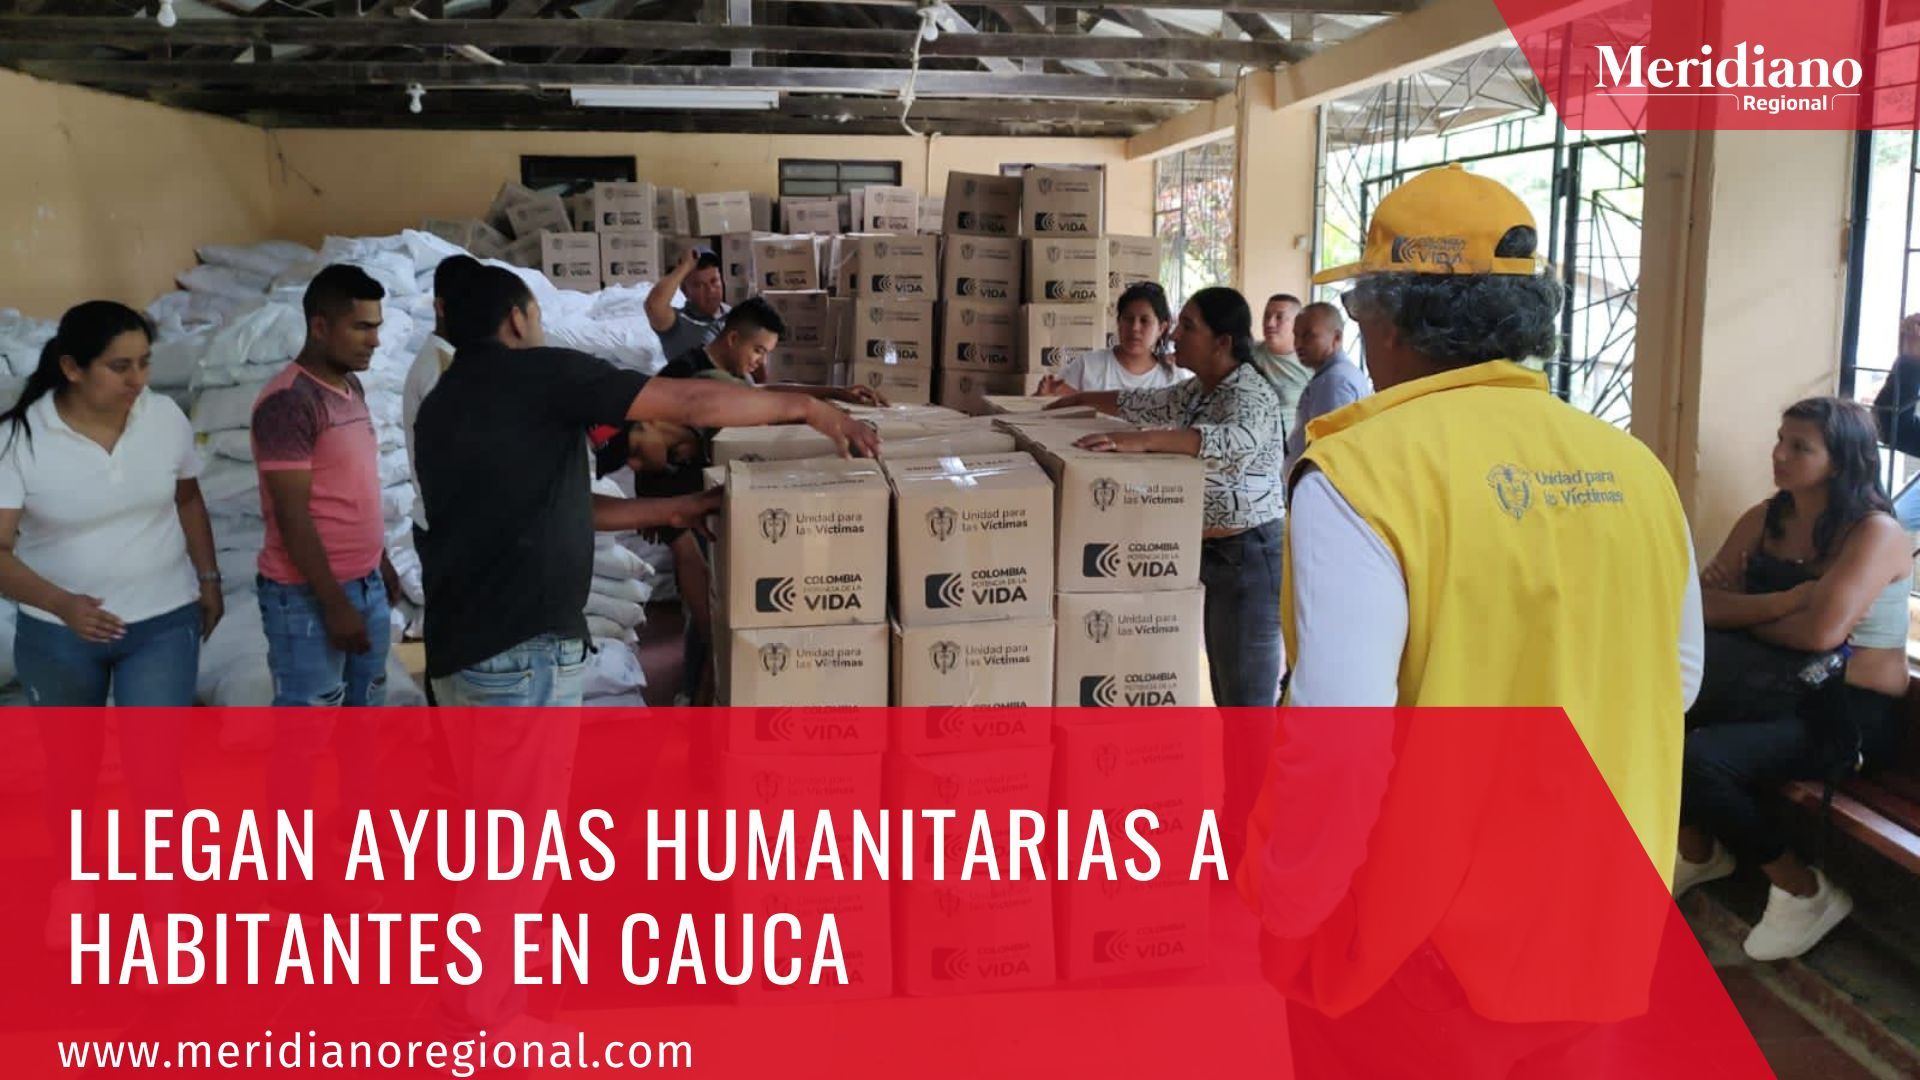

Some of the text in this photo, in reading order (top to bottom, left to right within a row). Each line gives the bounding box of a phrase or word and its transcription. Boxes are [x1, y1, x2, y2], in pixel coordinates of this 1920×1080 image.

[1058, 223, 1087, 232] VIDA
[1069, 290, 1097, 299] VIDA
[1585, 470, 1614, 486] para
[1140, 493, 1185, 505] Víctimas
[796, 512, 863, 526] Unidad para
[962, 508, 1026, 522] Unidad para
[815, 521, 865, 535] Víctimas
[980, 519, 1028, 531] Víctimas
[1128, 542, 1180, 552] COLOMBIA
[971, 566, 1027, 580] COLOMBIA
[1127, 560, 1178, 578] VIDA
[803, 573, 862, 586] COLOMBIA
[804, 592, 863, 612] VIDA
[971, 586, 1028, 605] VIDA
[1118, 613, 1177, 625] Unidad para
[1135, 624, 1180, 636] Víctimas
[796, 647, 862, 660] Unidad para
[966, 643, 1028, 656] Unidad para
[982, 654, 1031, 666] Víctimas
[1124, 671, 1177, 683] COLOMBIA
[1125, 690, 1177, 707] VIDA
[802, 723, 859, 740] VIDA
[972, 719, 1027, 738] VIDA
[1136, 941, 1185, 958] VIDA
[977, 960, 1031, 978] VIDA
